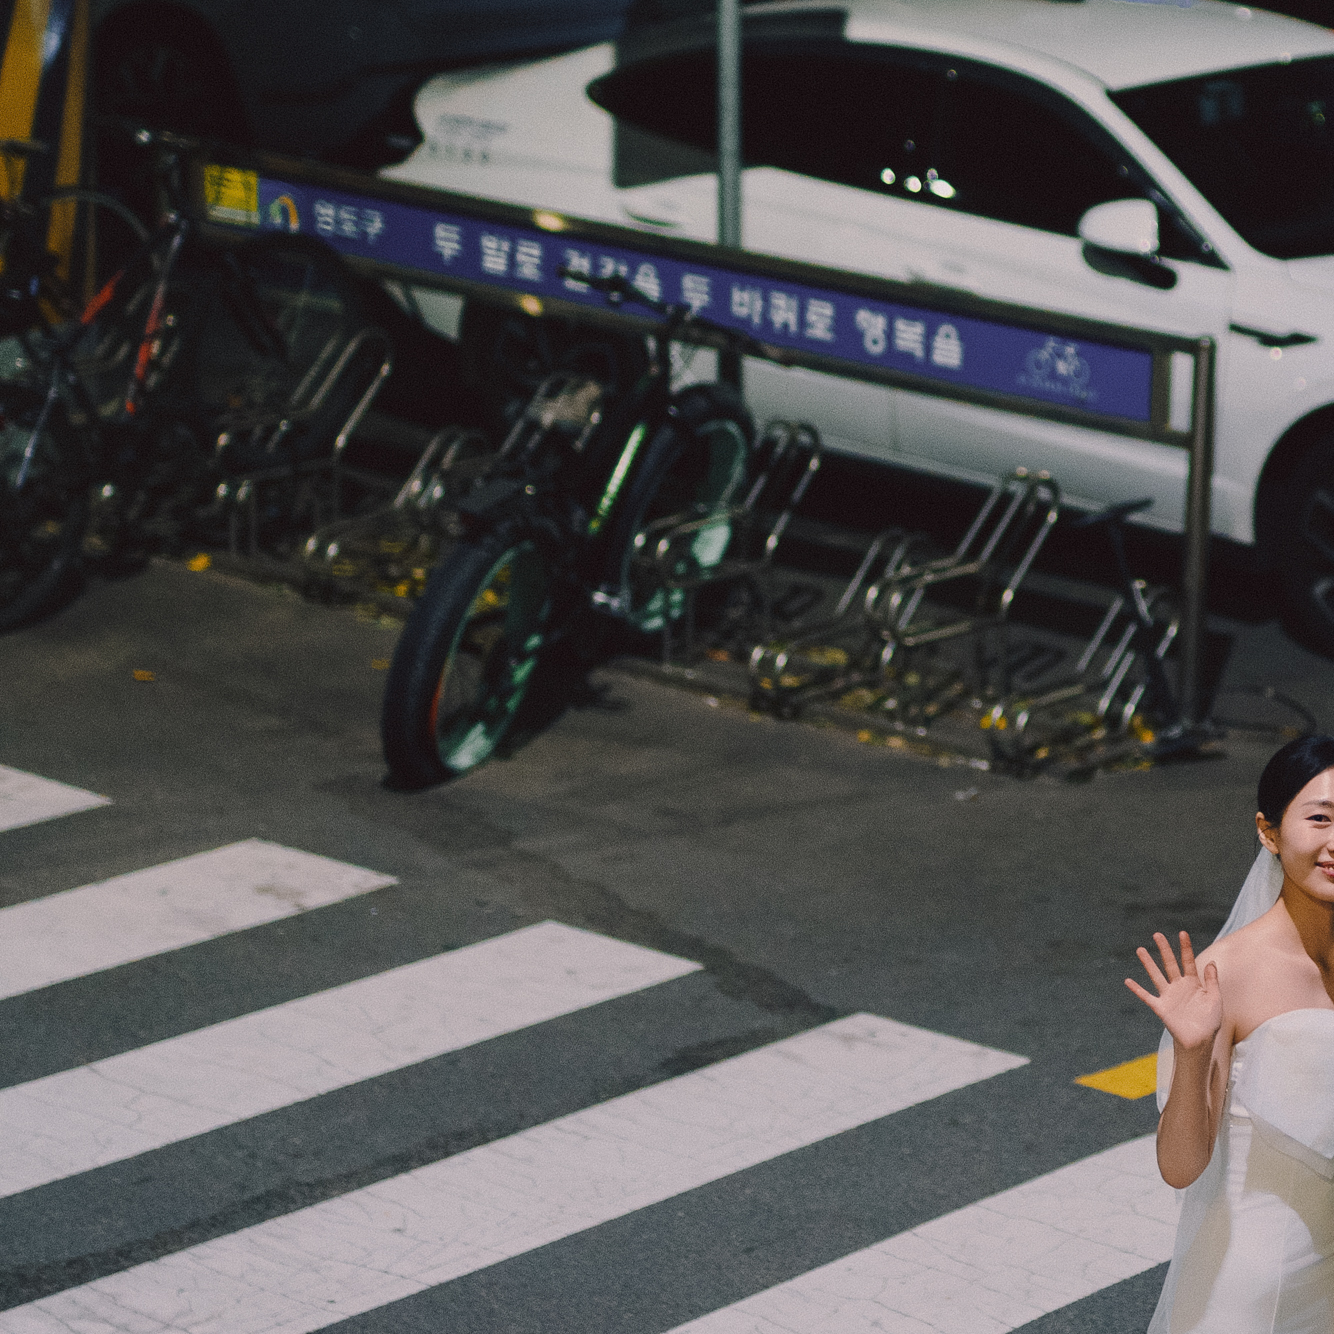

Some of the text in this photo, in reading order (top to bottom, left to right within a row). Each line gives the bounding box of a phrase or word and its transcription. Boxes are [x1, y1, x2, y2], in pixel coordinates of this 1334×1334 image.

[432, 221, 463, 264] 두
[480, 231, 544, 283] 발로
[681, 272, 712, 318] 두
[730, 281, 836, 343] 바퀴로
[854, 307, 963, 369] 행복을
